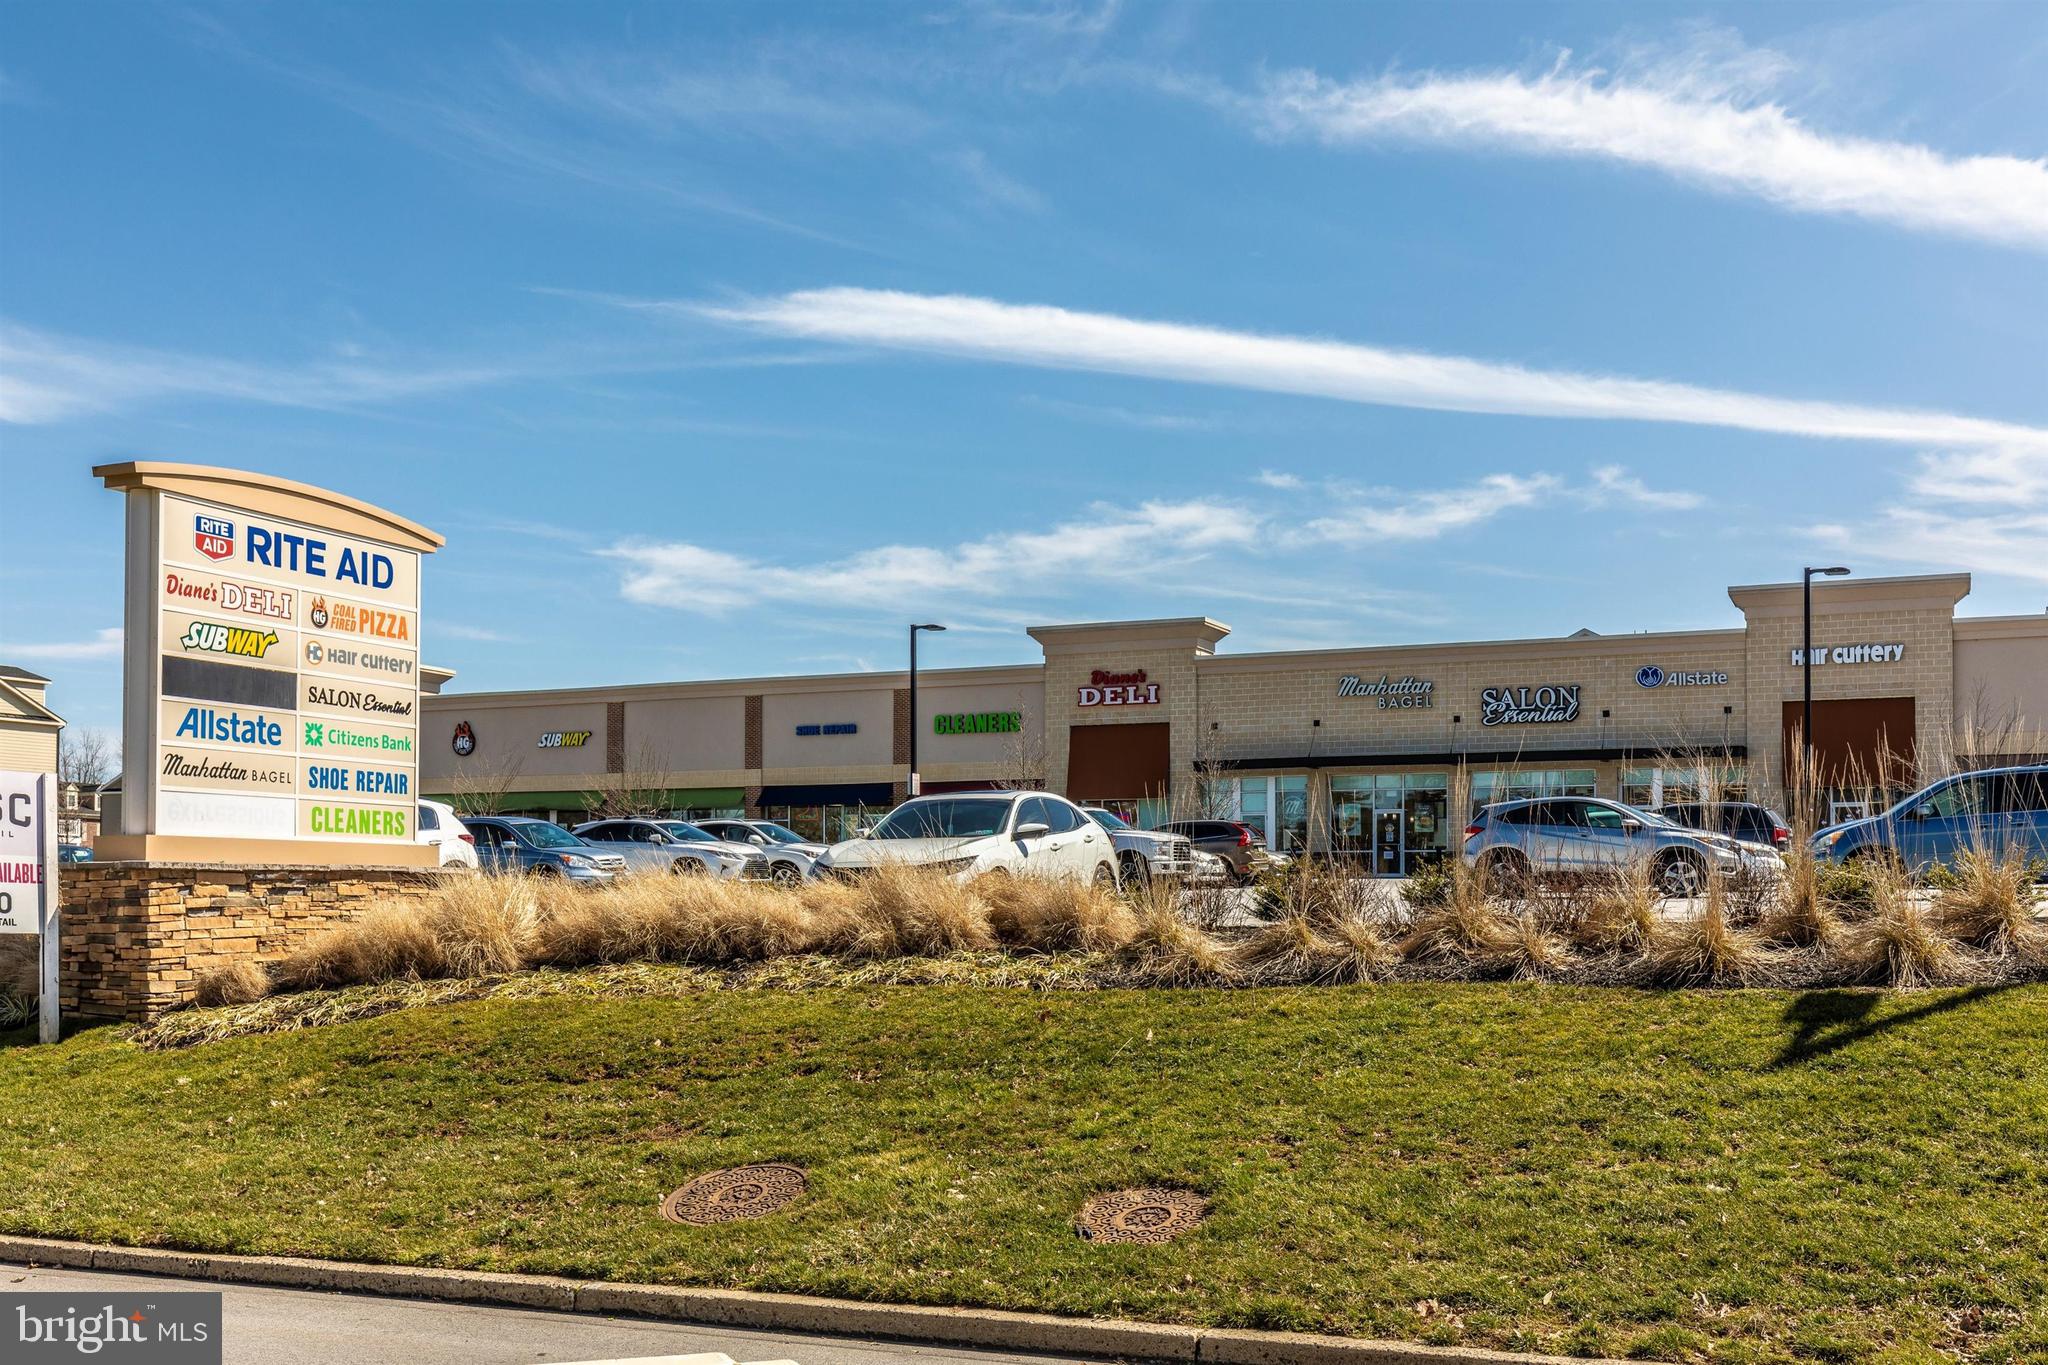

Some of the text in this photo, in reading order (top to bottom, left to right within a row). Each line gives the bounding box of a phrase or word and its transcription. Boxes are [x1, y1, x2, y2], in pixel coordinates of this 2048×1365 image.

[200, 518, 229, 537] RITE
[202, 537, 227, 554] AID
[247, 525, 394, 589] RITE AID
[166, 574, 292, 620] Diane's DELI
[312, 609, 326, 624] HG
[333, 603, 356, 619] COAL
[330, 616, 357, 632] FIRED
[359, 608, 409, 640] PIZZA
[180, 621, 279, 659] SUBWAY
[327, 648, 358, 666] Hair
[1337, 675, 1433, 697] Manhattan
[1665, 671, 1728, 687] Allstate
[308, 685, 412, 716] SALON Essential
[1078, 684, 1160, 707] DELI
[1378, 695, 1432, 709] BAGEL
[1482, 686, 1579, 711] SALON
[934, 712, 1021, 735] CLEANERS
[1482, 701, 1579, 726] Essential
[175, 707, 282, 746] Allstate
[328, 729, 412, 752] Citizens Bank
[537, 730, 592, 748] SUBWAY
[162, 753, 292, 784] Manhattan BAGEL
[308, 765, 408, 795] SHOE REPAIR
[311, 806, 406, 837] CLEANERS
